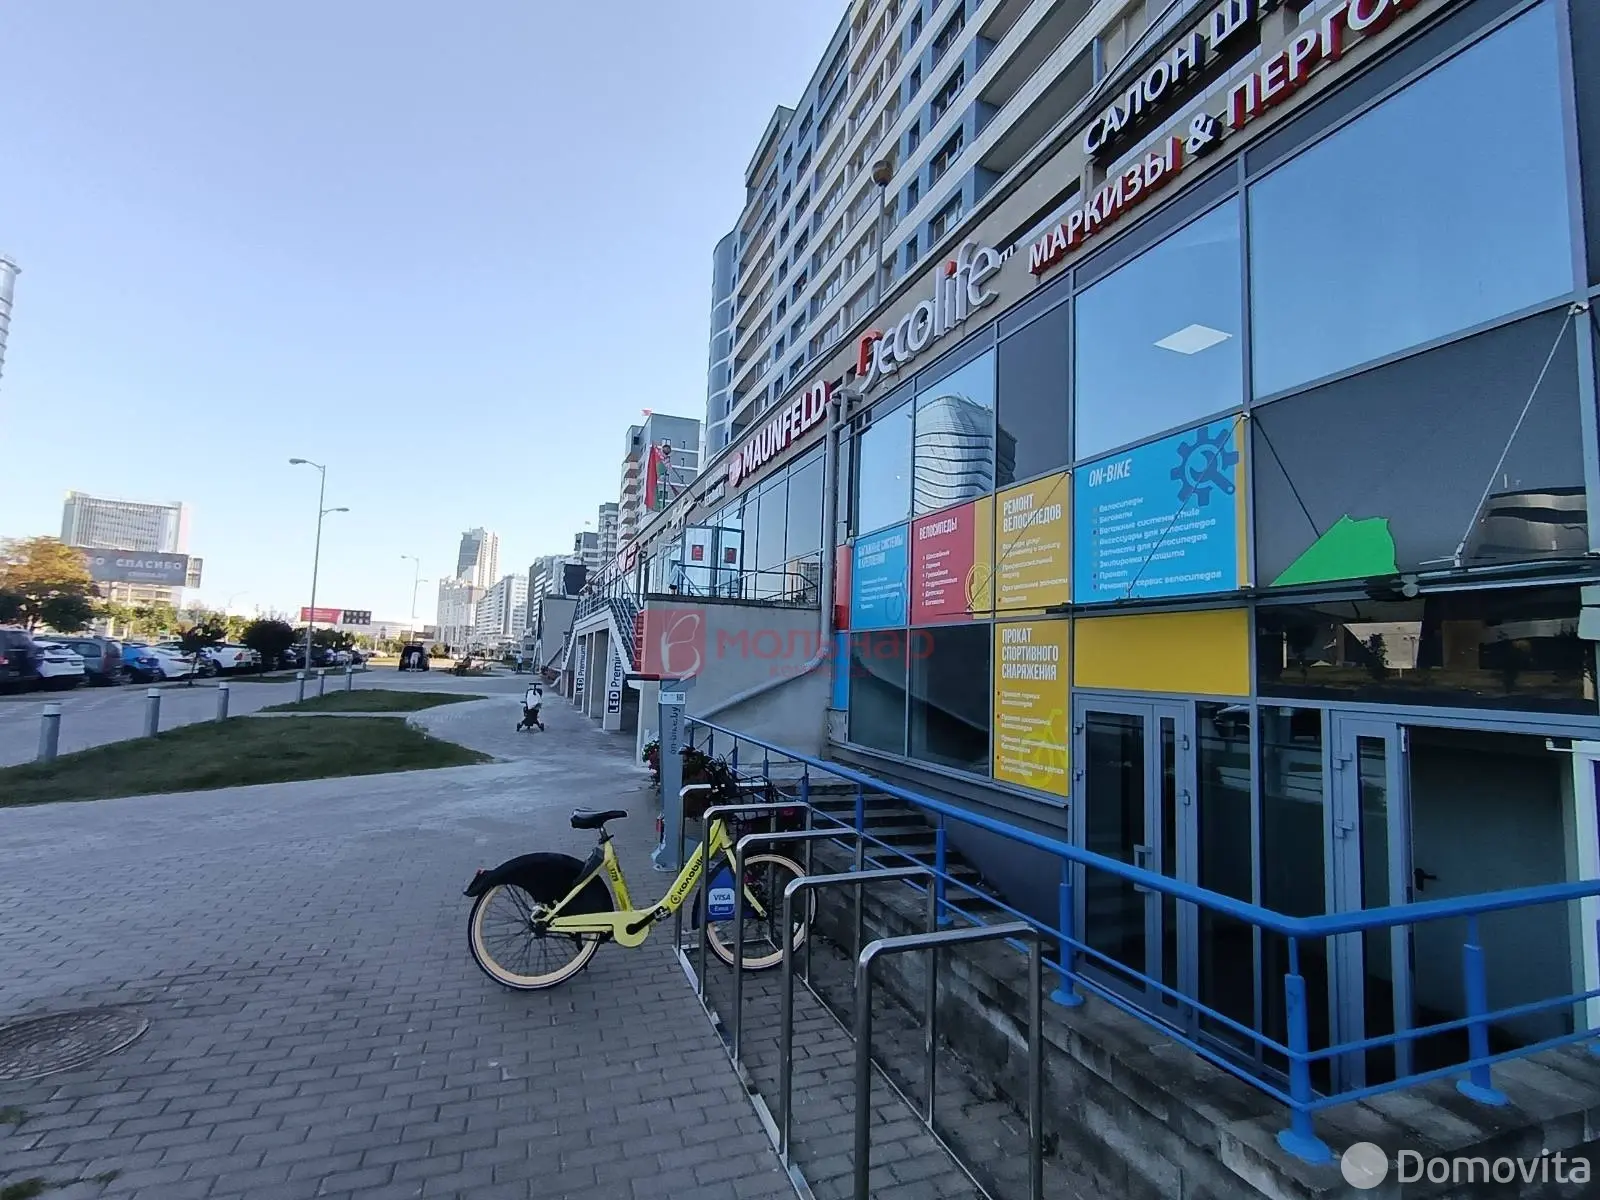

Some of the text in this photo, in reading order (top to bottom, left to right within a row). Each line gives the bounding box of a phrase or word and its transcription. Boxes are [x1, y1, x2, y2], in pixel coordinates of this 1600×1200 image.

[1083, 31, 1202, 156] САЛОН
[1029, 0, 1404, 274] МАРКИЗЫ & ПЕРГО
[741, 380, 830, 479] MAUNFELD
[1089, 458, 1132, 488] ON-BIKE
[1003, 493, 1034, 517] РЕМОНТ
[919, 517, 957, 540] ВЕЛОСИПЕДЫ
[1003, 503, 1062, 533] ВЕЛОСИПЕДОВ
[116, 558, 182, 570] СПАСИБО
[1002, 628, 1033, 644] ПРОКАТ
[1001, 645, 1059, 662] СПОРТИВНОГО
[1001, 663, 1057, 681] СНАРЯЖЕНИЯ
[576, 678, 584, 693] LED
[609, 691, 620, 713] LED
